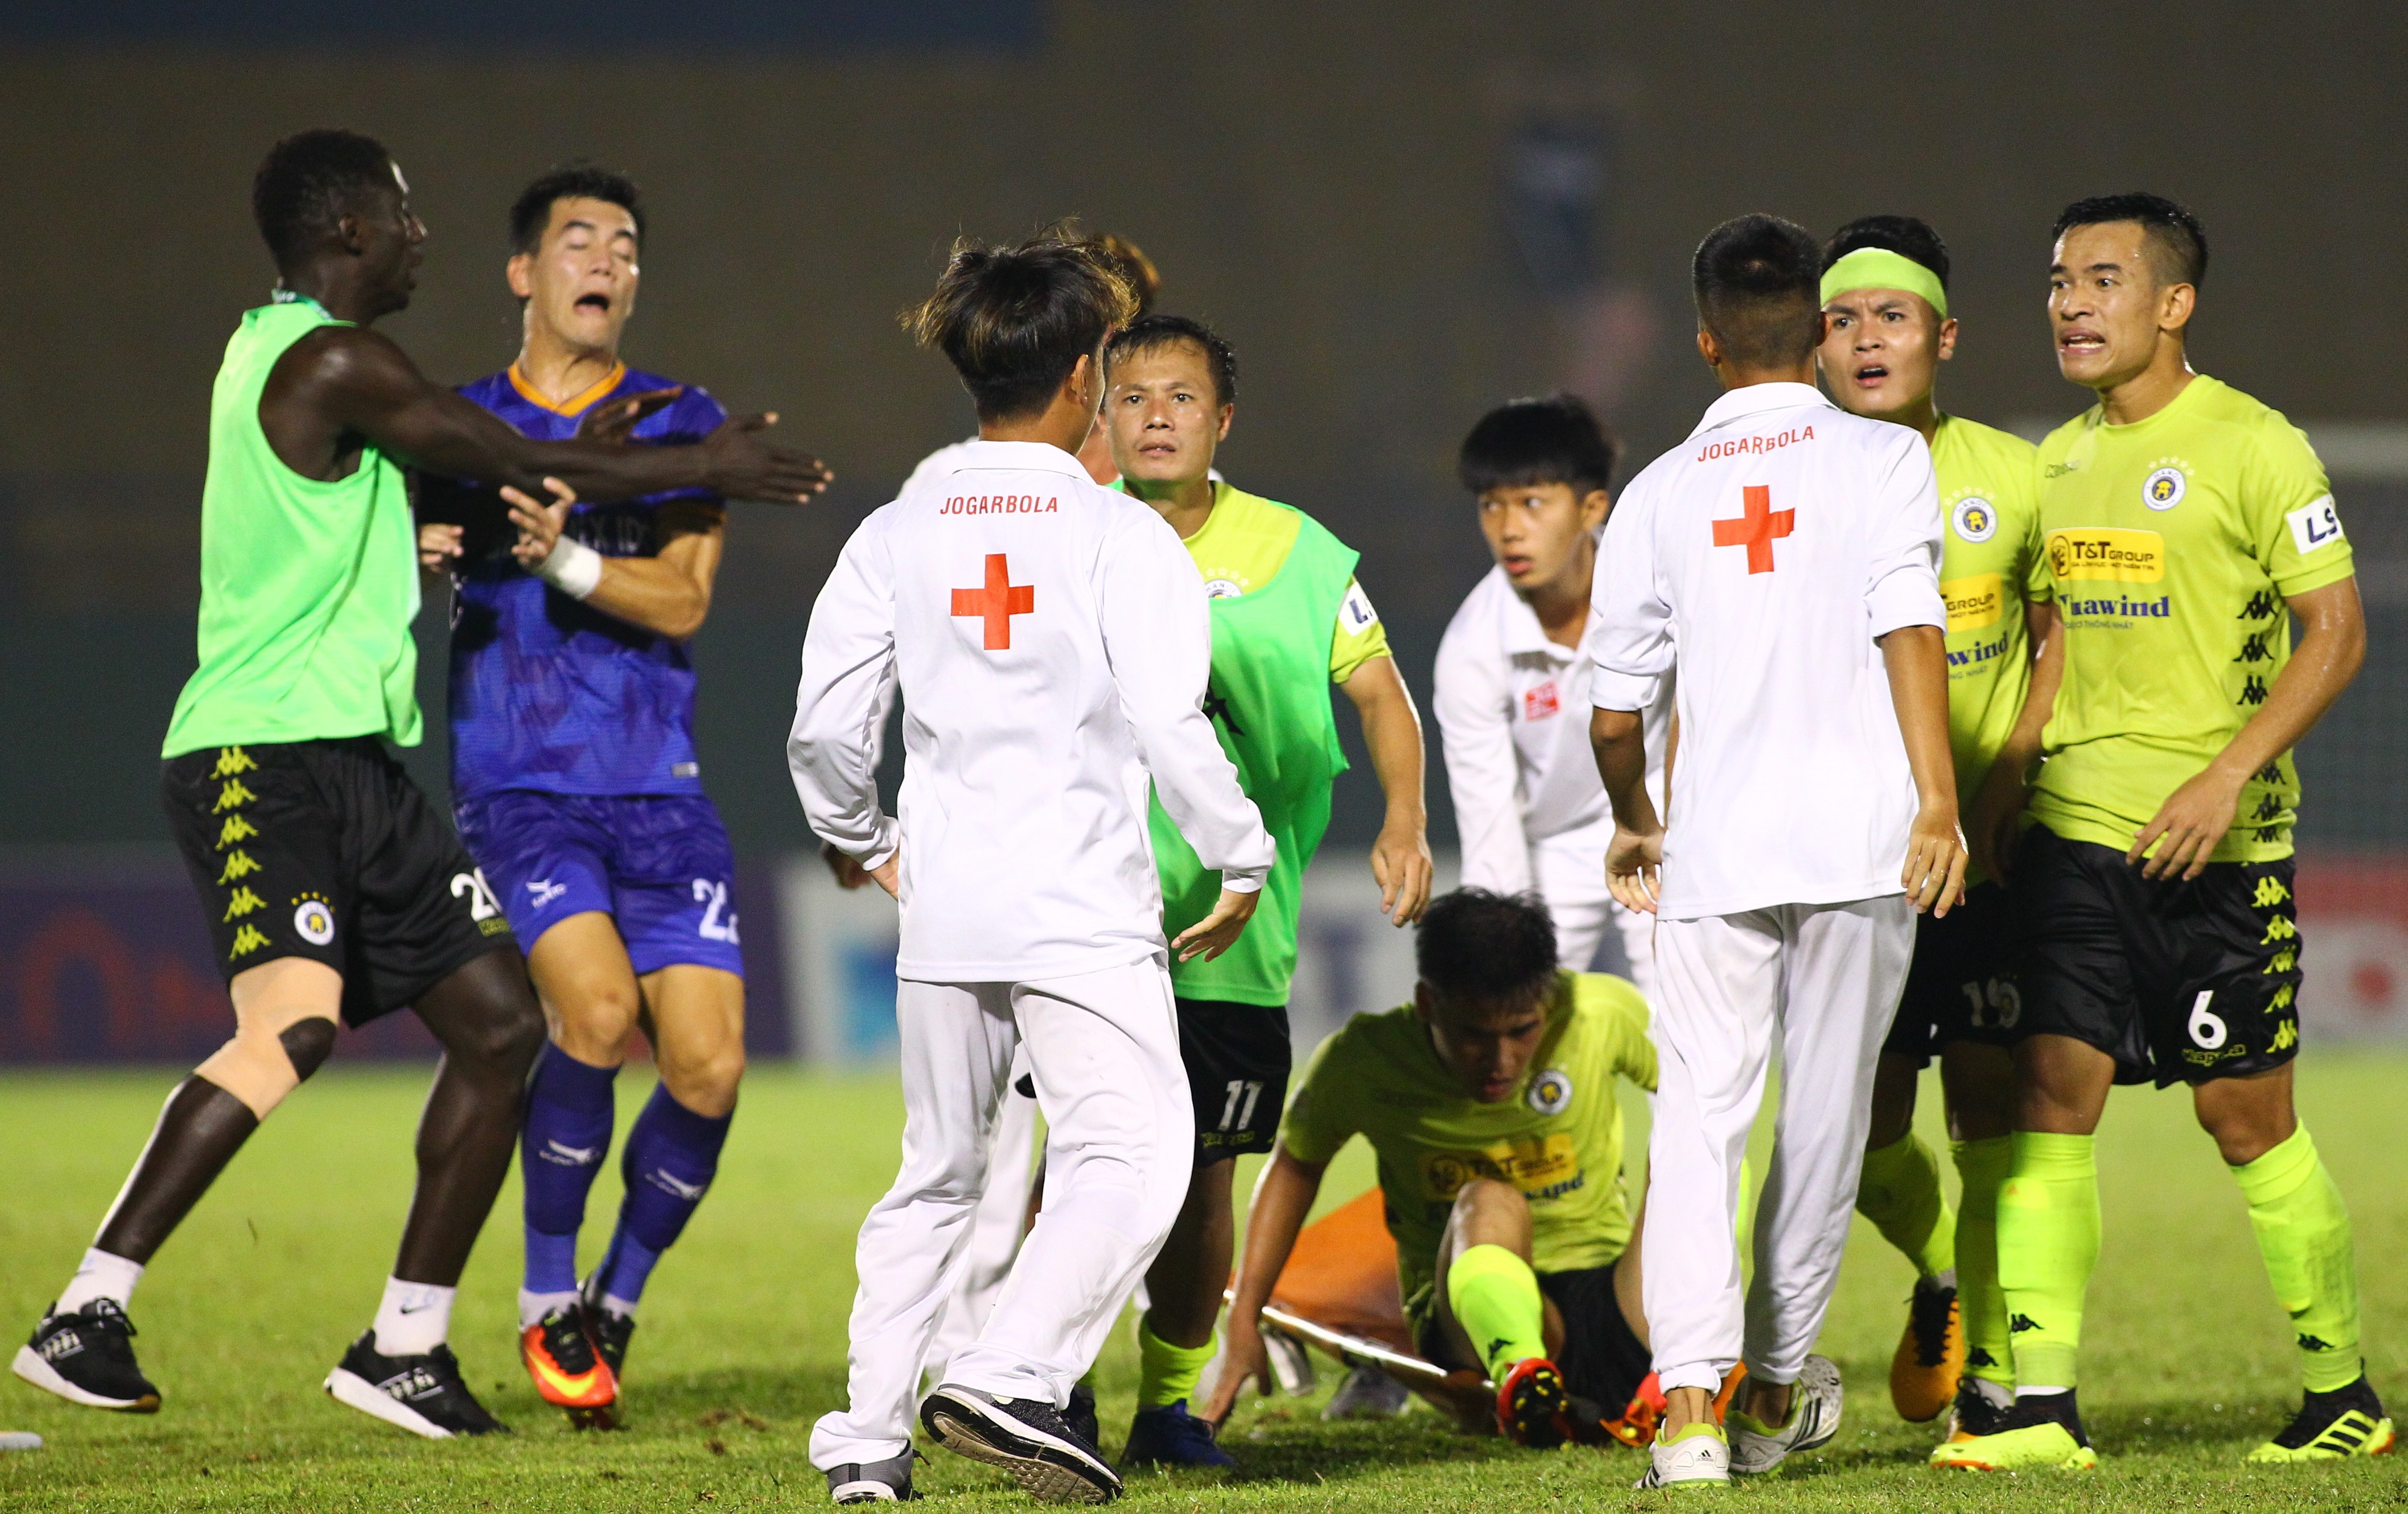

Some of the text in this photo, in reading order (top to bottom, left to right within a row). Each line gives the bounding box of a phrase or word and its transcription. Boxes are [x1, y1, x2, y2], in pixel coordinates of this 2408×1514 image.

[1697, 426, 1814, 462] JOGARBOLA
[940, 495, 1057, 515] JOGARBOLA
[2188, 989, 2227, 1050] 6
[1218, 1080, 1264, 1131] 11
